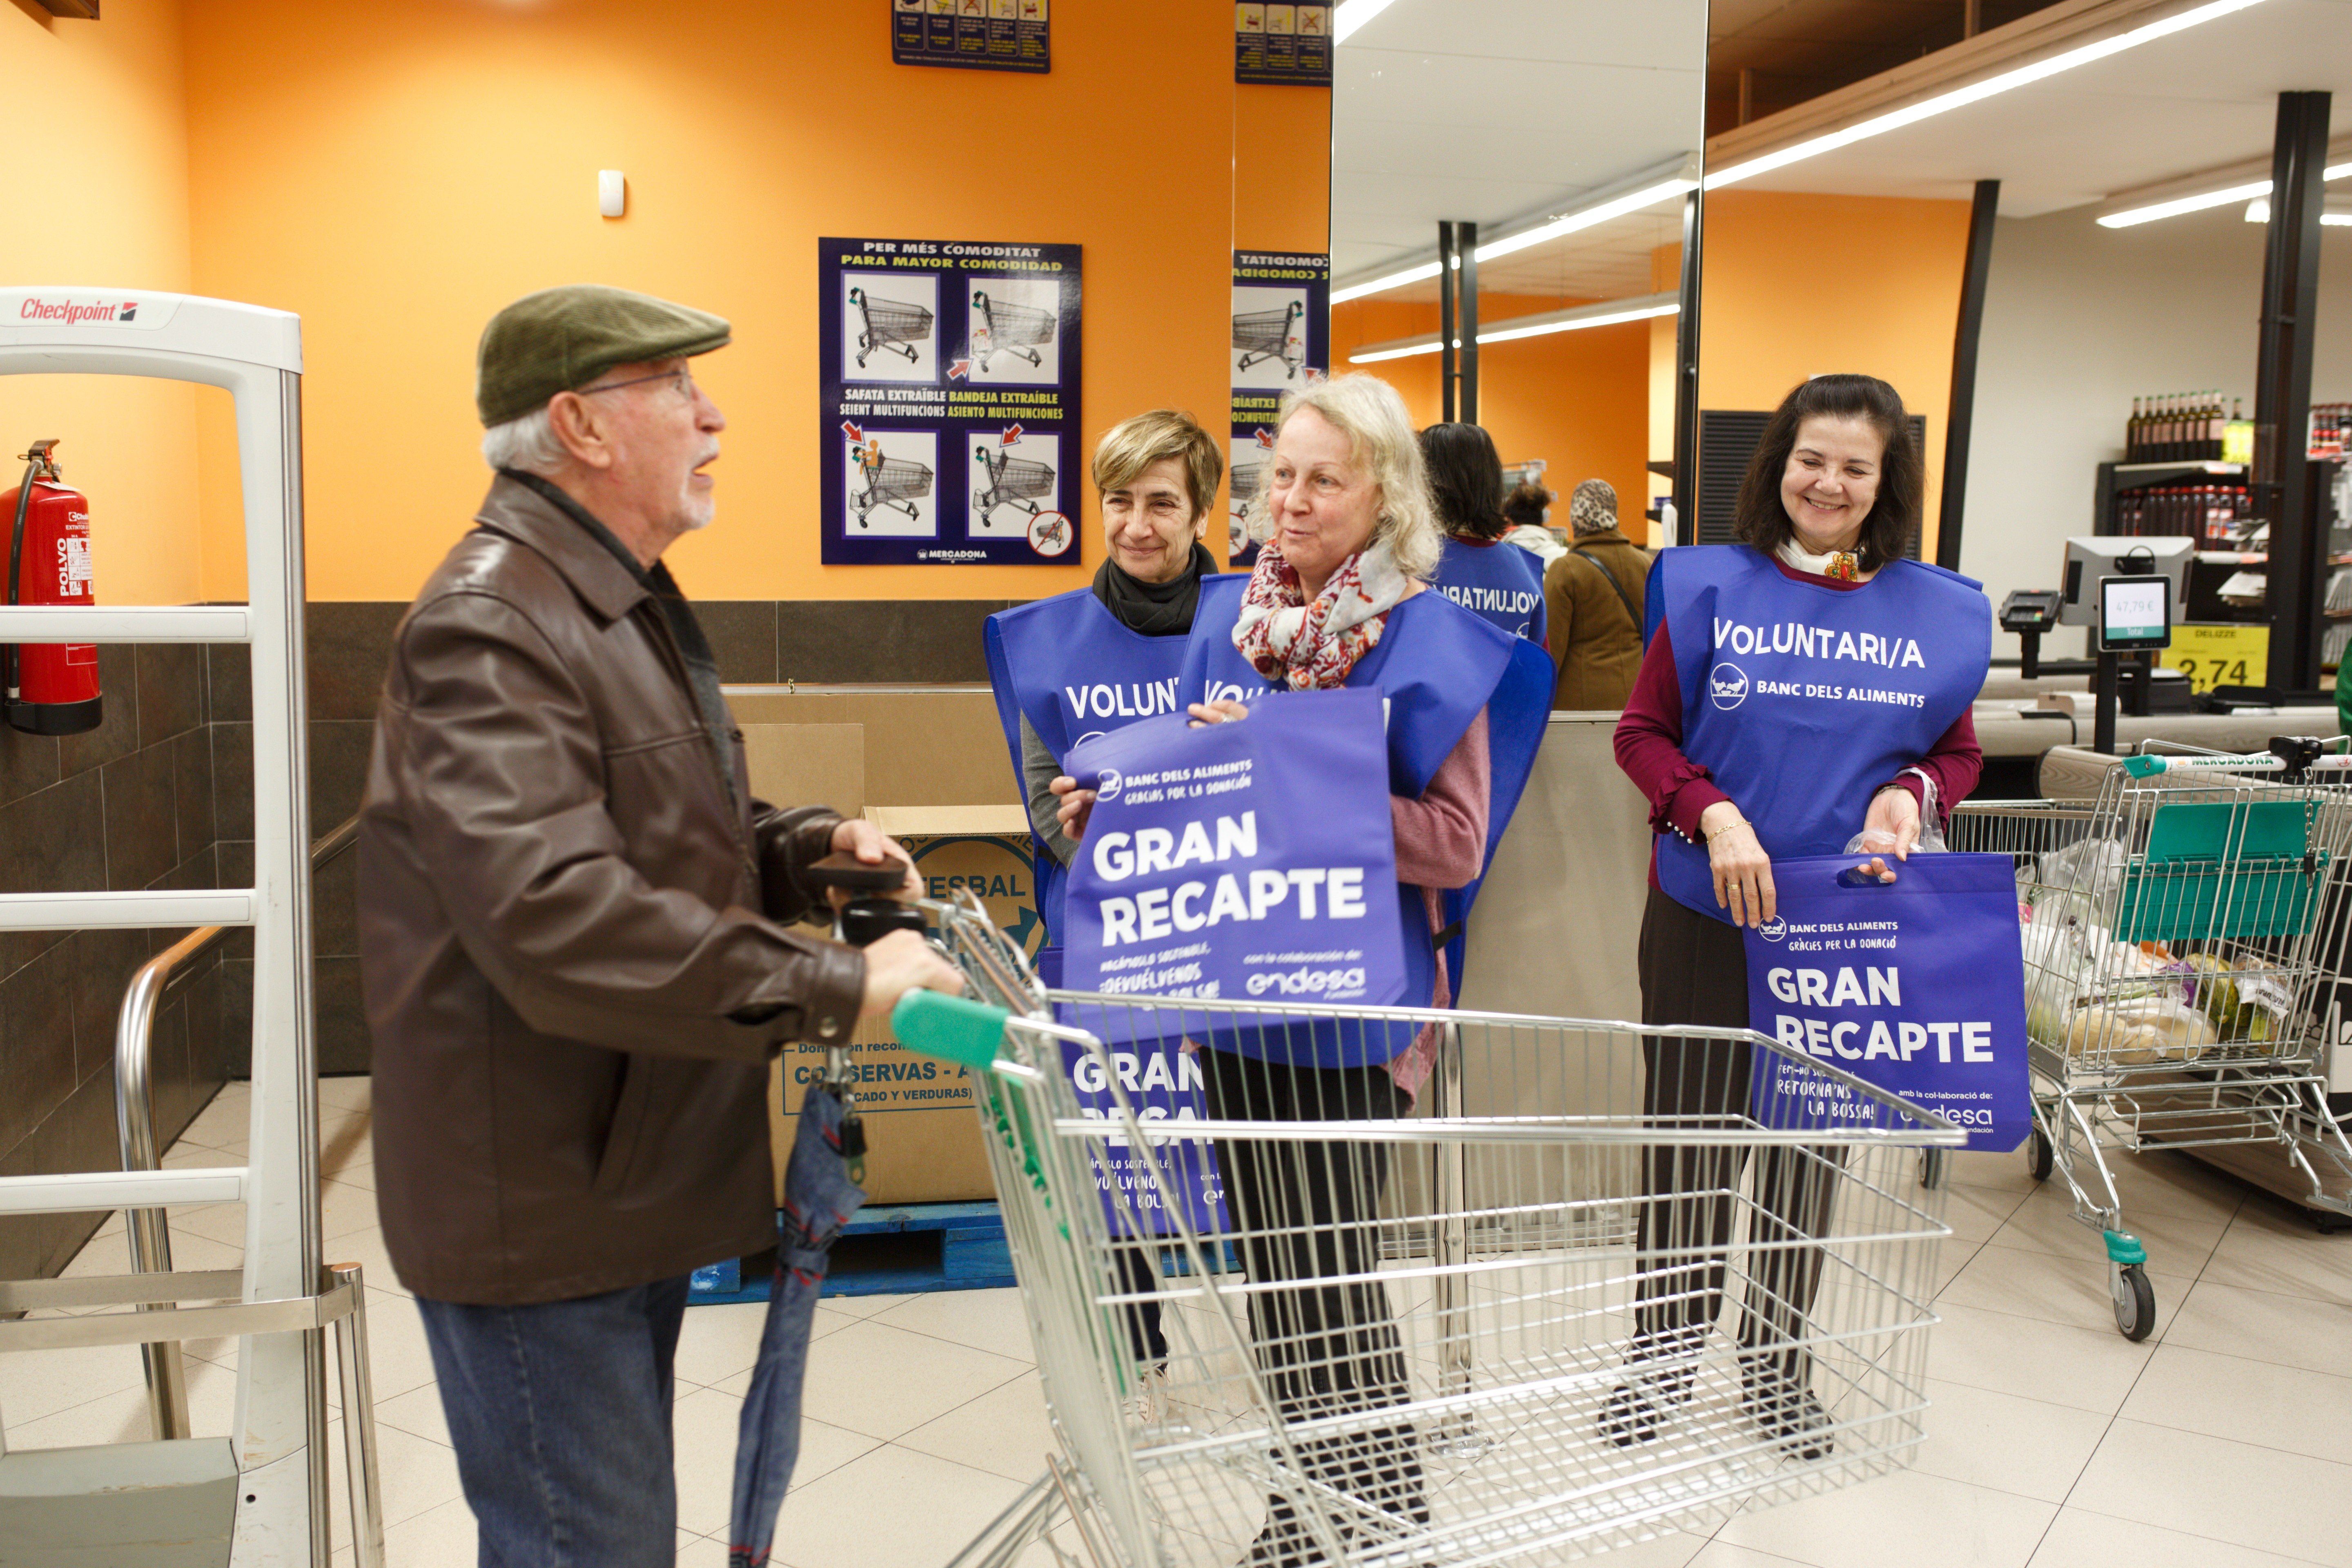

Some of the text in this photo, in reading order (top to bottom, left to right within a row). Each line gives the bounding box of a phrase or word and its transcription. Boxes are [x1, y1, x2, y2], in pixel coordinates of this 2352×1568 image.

[864, 242, 1041, 257] PER MÉS COMODITAT
[841, 255, 1062, 271] PARA MAYOR COMODIDAD
[20, 298, 116, 325] Checkpoint
[845, 388, 946, 402] SAFATA EXTRAÏBLE
[949, 391, 1058, 404] BANDEJA EXTRAÍBLE
[840, 403, 945, 417] SEIENT MULTIFUNCIONS
[947, 406, 1064, 419] ASIENTO MULTIFUNCIONES
[929, 550, 987, 558] MERCADONA
[57, 538, 69, 596] POLVO
[2117, 600, 2154, 613] 47,79 €
[2127, 627, 2143, 636] Total
[1714, 617, 1925, 668] VOLUNTARI/A
[2178, 658, 2248, 689] 2,74
[1757, 680, 1925, 708] BANC DELS ALIMENTS
[2192, 756, 2274, 765] MERCADONA
[1125, 759, 1252, 788] BANC DELS ALIMENTS
[1167, 786, 1186, 800] POR
[1189, 783, 1203, 797] LA
[1093, 811, 1258, 882] GRAN
[1100, 867, 1366, 947] RECAPTE
[1790, 922, 1898, 933] BANC DELS ALIMENTS
[1826, 940, 1841, 950] PER
[1844, 939, 1856, 949] LA
[1246, 966, 1365, 995] endesa
[1768, 967, 1900, 1006] GRAN
[1776, 1014, 1993, 1062] RECAPTE
[1074, 1052, 1204, 1093] GRAN
[1778, 1065, 1809, 1075] FEM-HO
[891, 1091, 899, 1100] Y
[903, 1088, 972, 1100] VERDURAS)
[1809, 1100, 1874, 1120] LA BOSSA!
[1900, 1104, 1992, 1125] edesa
